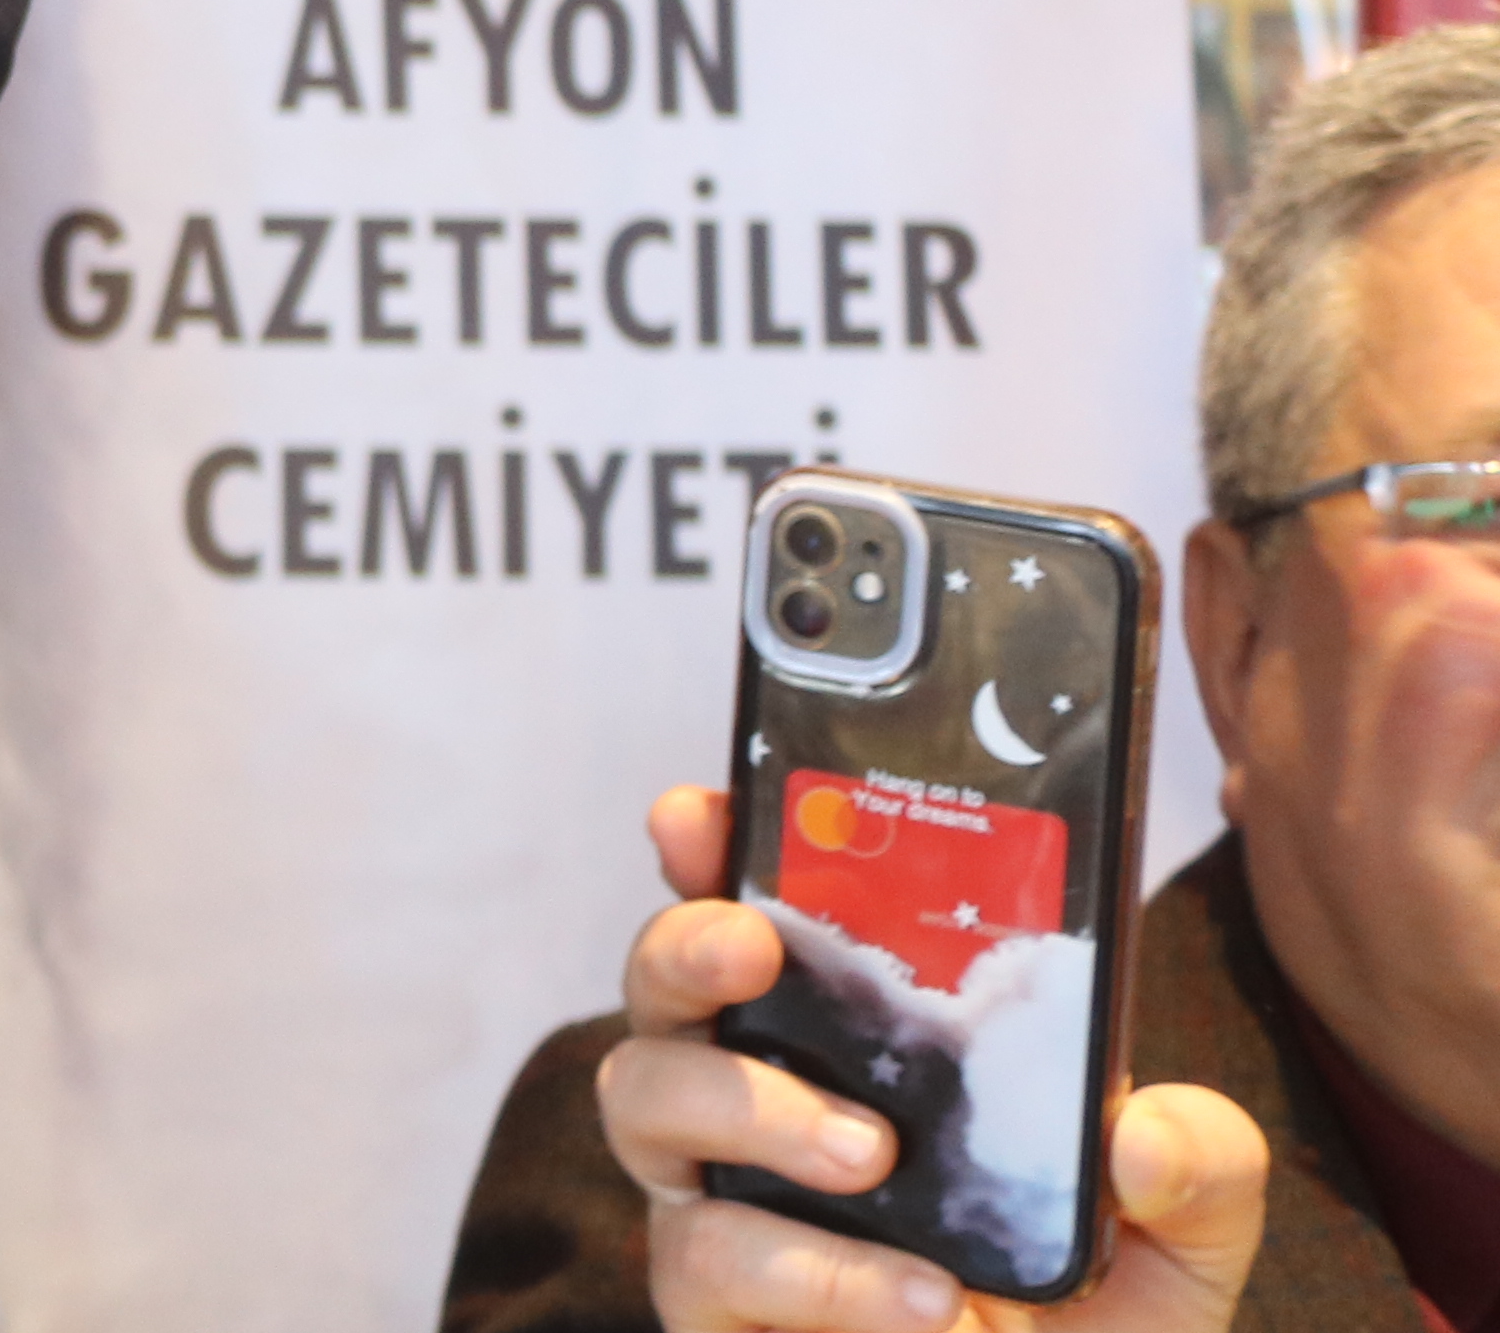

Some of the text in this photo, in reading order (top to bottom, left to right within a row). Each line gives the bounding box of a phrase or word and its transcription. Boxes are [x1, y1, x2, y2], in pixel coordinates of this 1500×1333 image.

[31, 176, 982, 351] GAZETECİLER
[864, 767, 987, 809] Hang on to
